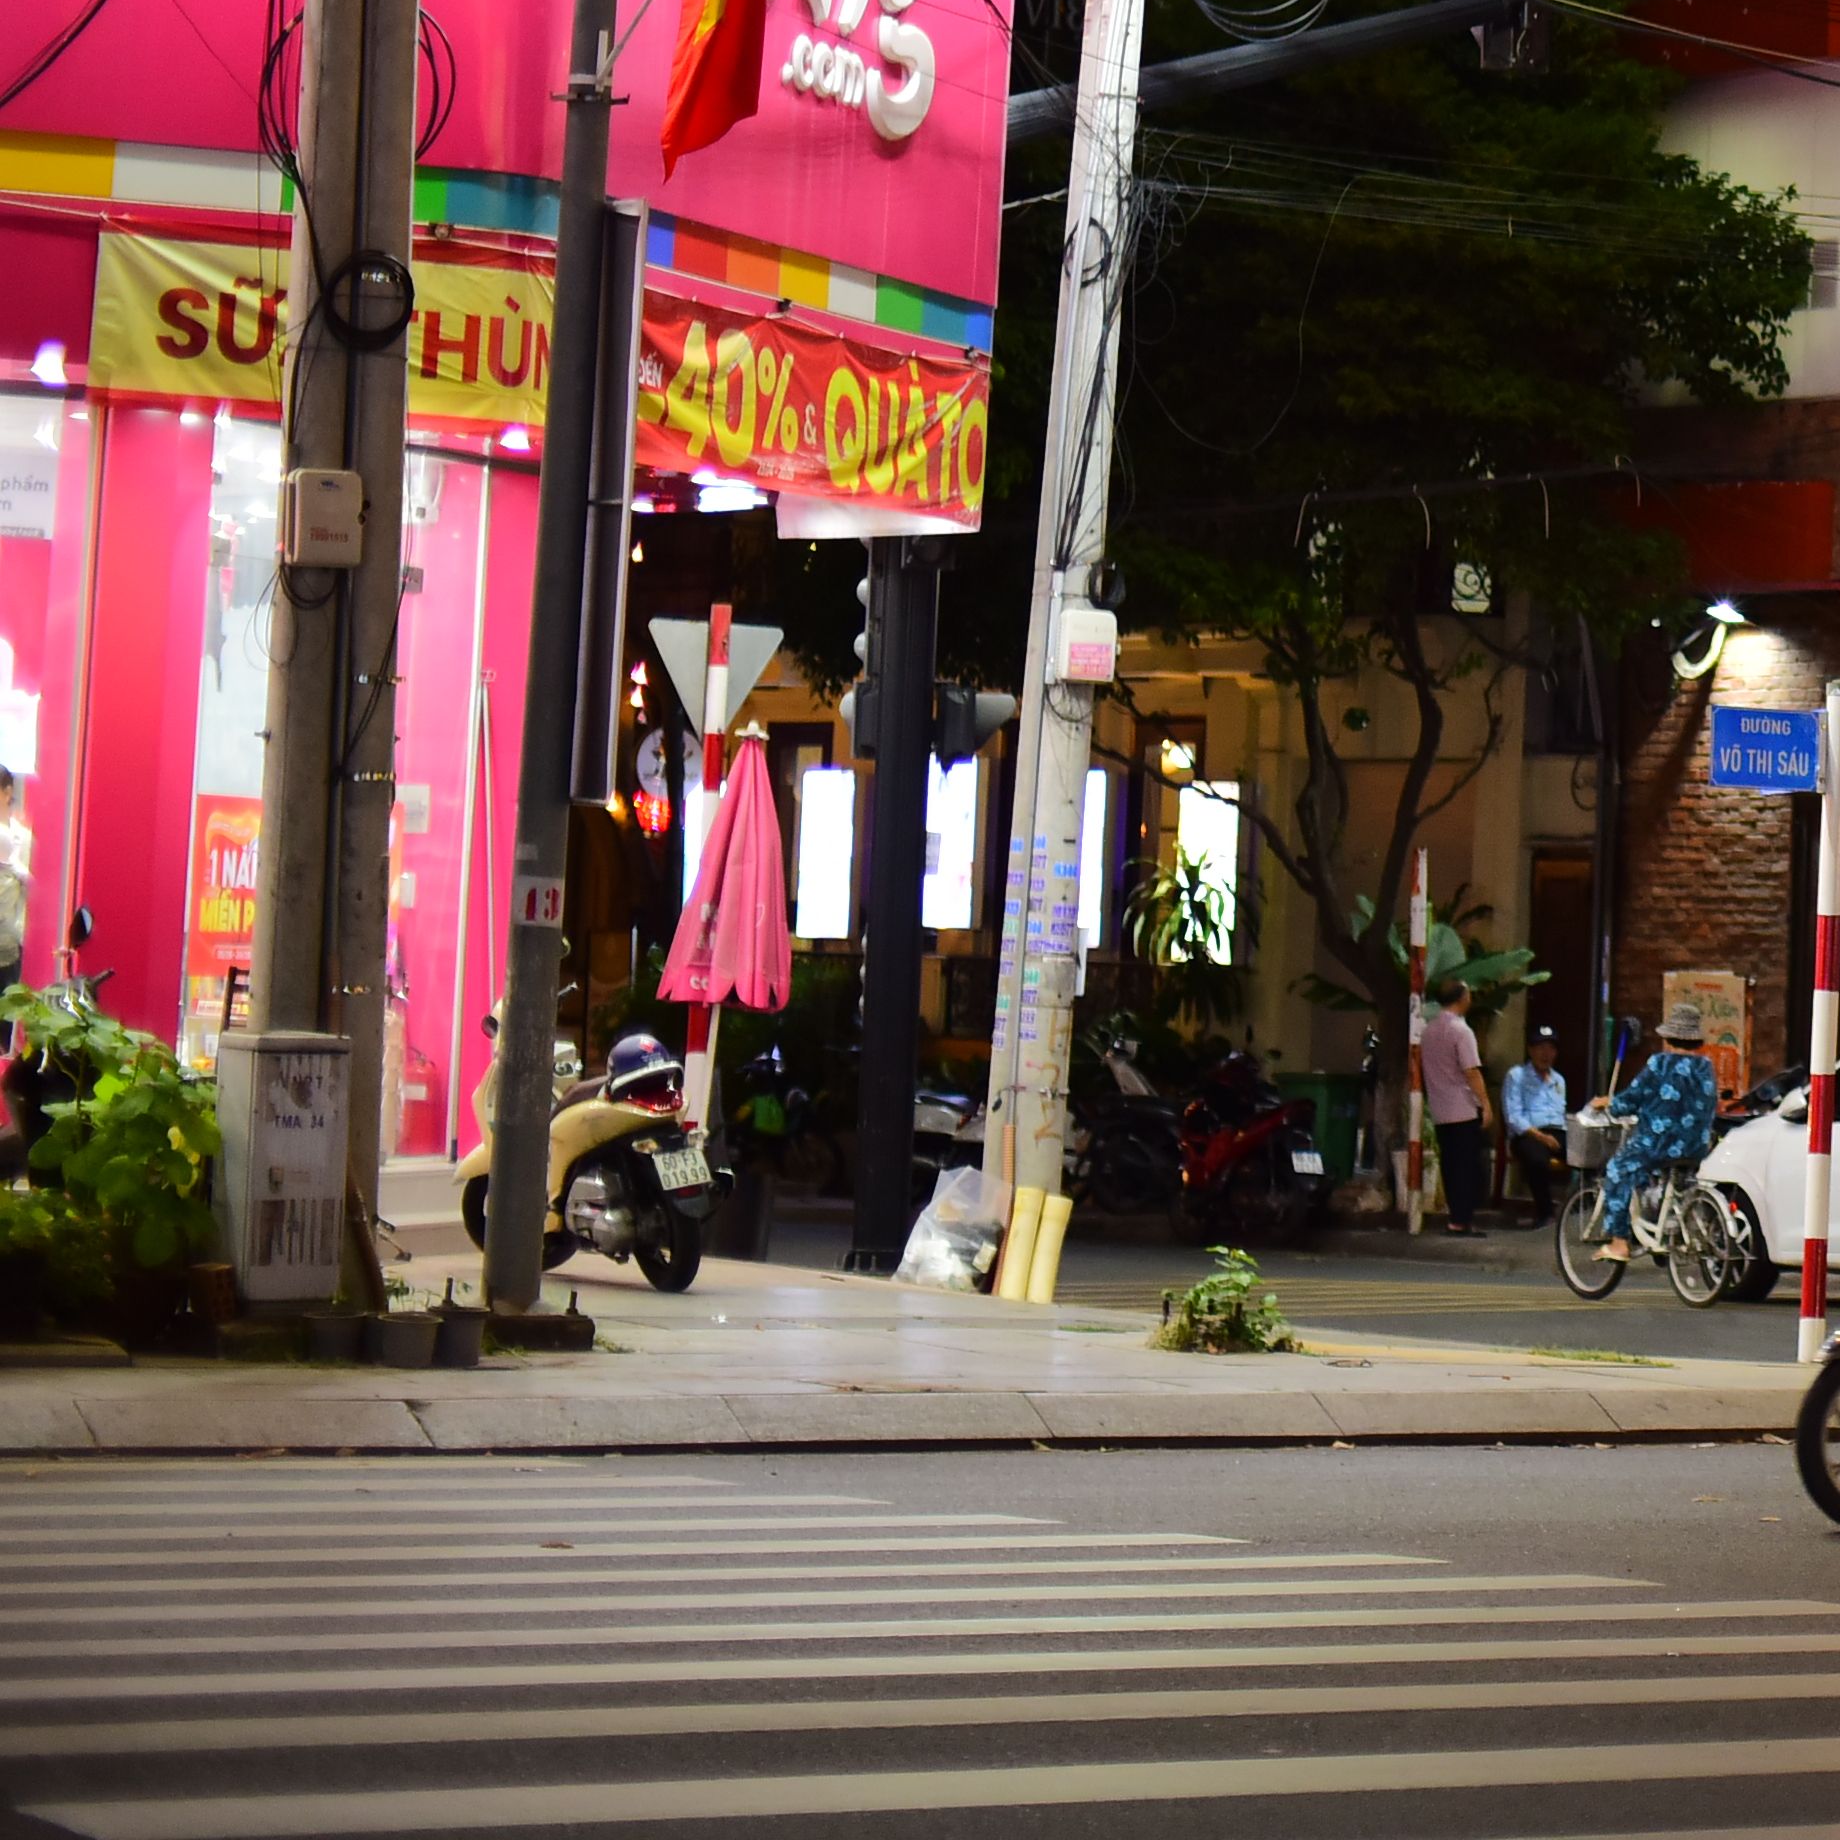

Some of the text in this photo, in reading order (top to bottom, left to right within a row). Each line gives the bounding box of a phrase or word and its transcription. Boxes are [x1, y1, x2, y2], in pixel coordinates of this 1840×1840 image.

[825, 359, 930, 502] QUÀ
[1740, 715, 1792, 736] ĐƯỜNG
[1720, 743, 1810, 779] VÕ THỊ SÁU
[525, 886, 560, 922] 13
